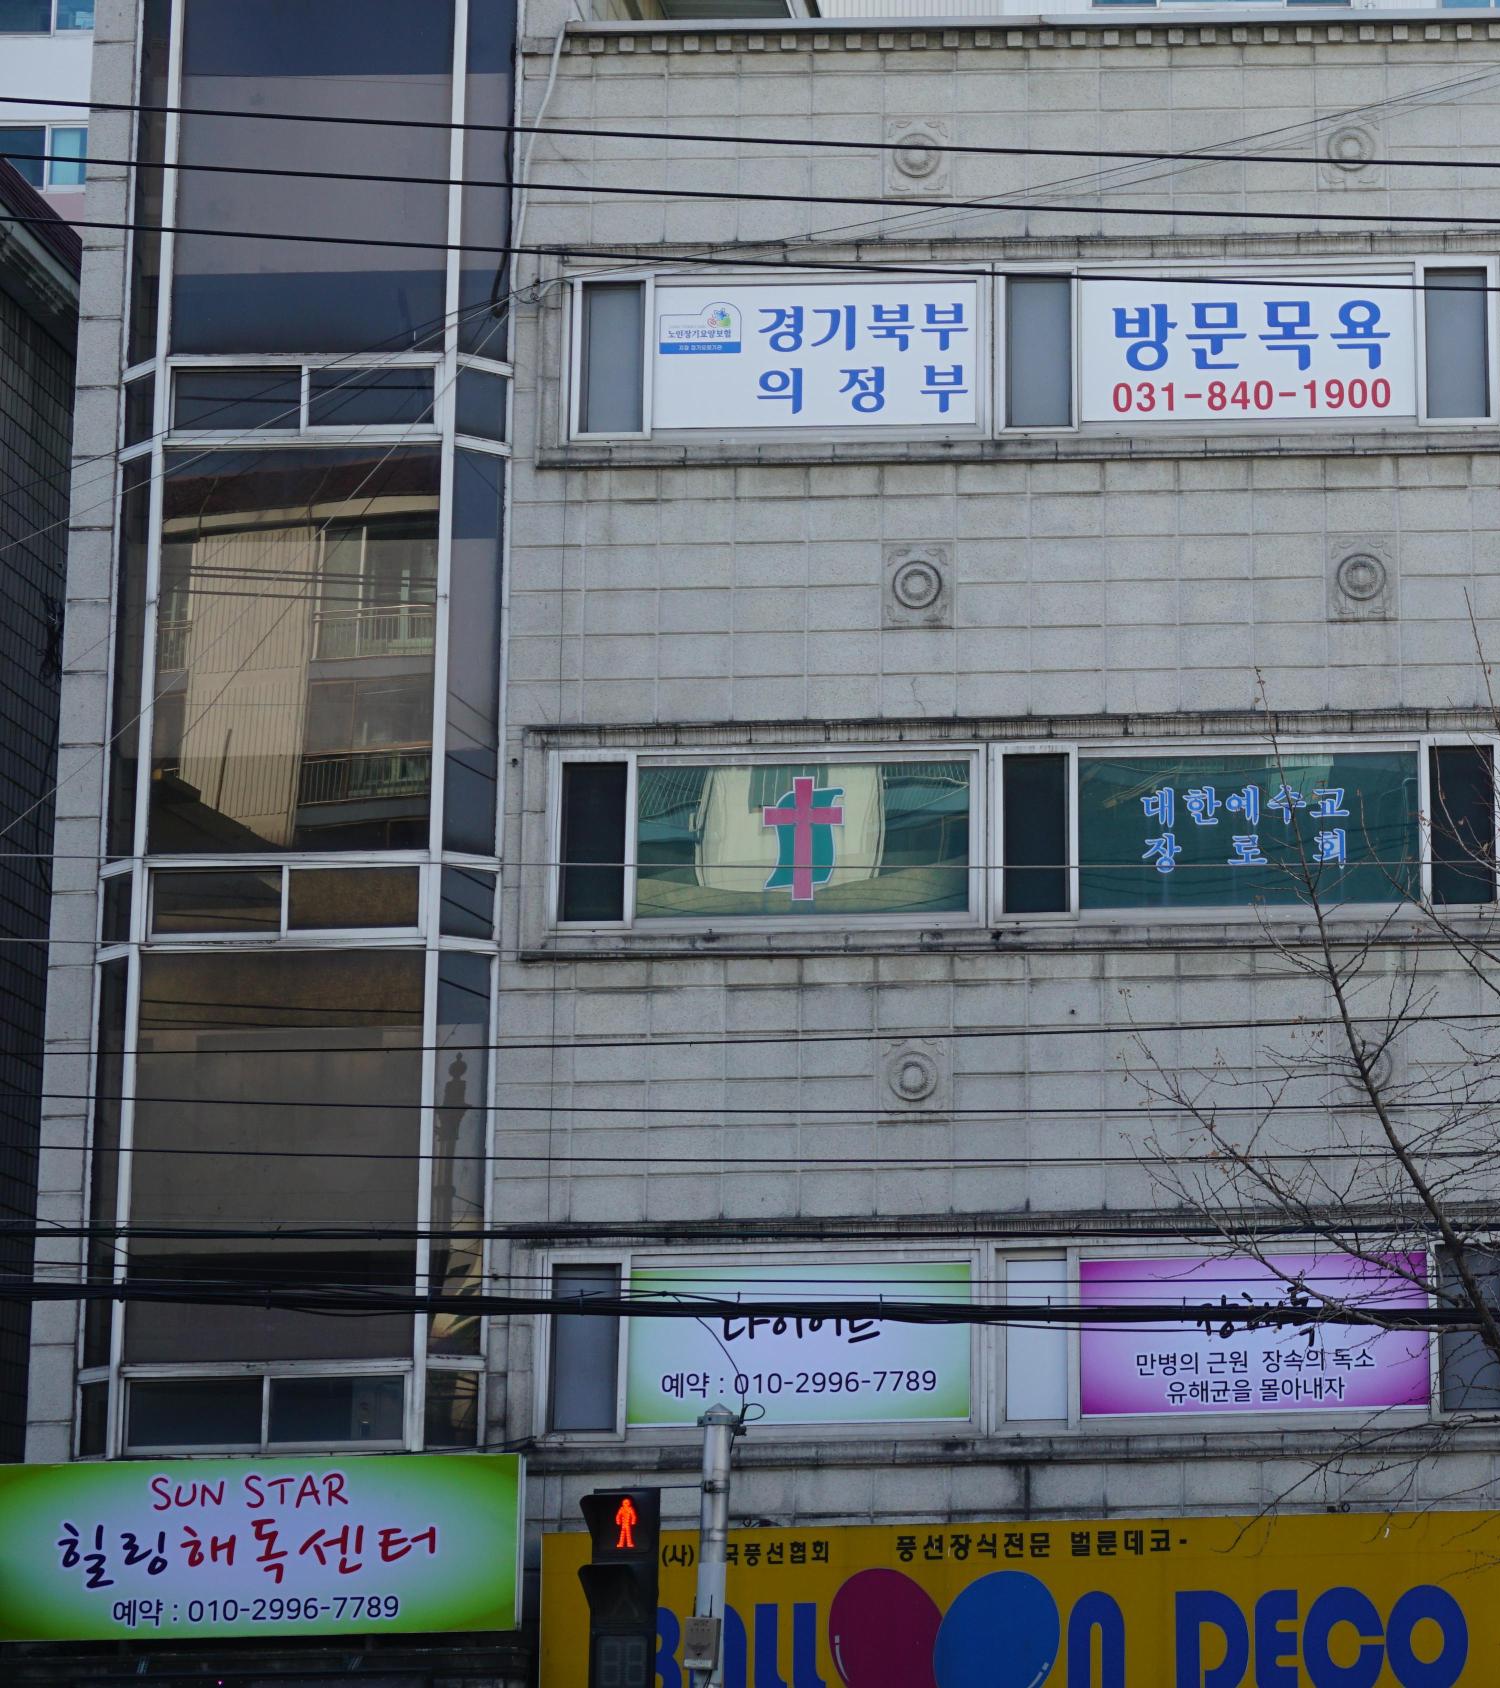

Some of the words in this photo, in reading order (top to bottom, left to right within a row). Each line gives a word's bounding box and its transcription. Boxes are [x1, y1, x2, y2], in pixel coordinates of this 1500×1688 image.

[758, 303, 969, 352] 경기북부
[1112, 299, 1392, 372] 방문목욕
[1111, 378, 1392, 414] 031-840-1900
[1140, 784, 1350, 828] 대한예수교
[1136, 1352, 1199, 1377] 만병의
[1206, 1351, 1248, 1374] 근원
[1262, 1350, 1325, 1373] 장속의
[1332, 1349, 1375, 1371] 독소
[661, 1372, 710, 1399] 예약
[734, 1370, 936, 1395] 010-2996-7789
[1167, 1379, 1252, 1404] 유해균을
[1259, 1376, 1345, 1402] 몰아내자
[151, 1477, 226, 1511] SUN
[244, 1473, 349, 1509] STAR
[895, 1532, 1050, 1562] 풍선장식전문
[113, 1598, 164, 1627] 예약
[188, 1595, 400, 1623] 010-2996-7789
[1175, 1584, 1470, 1688] DECO
